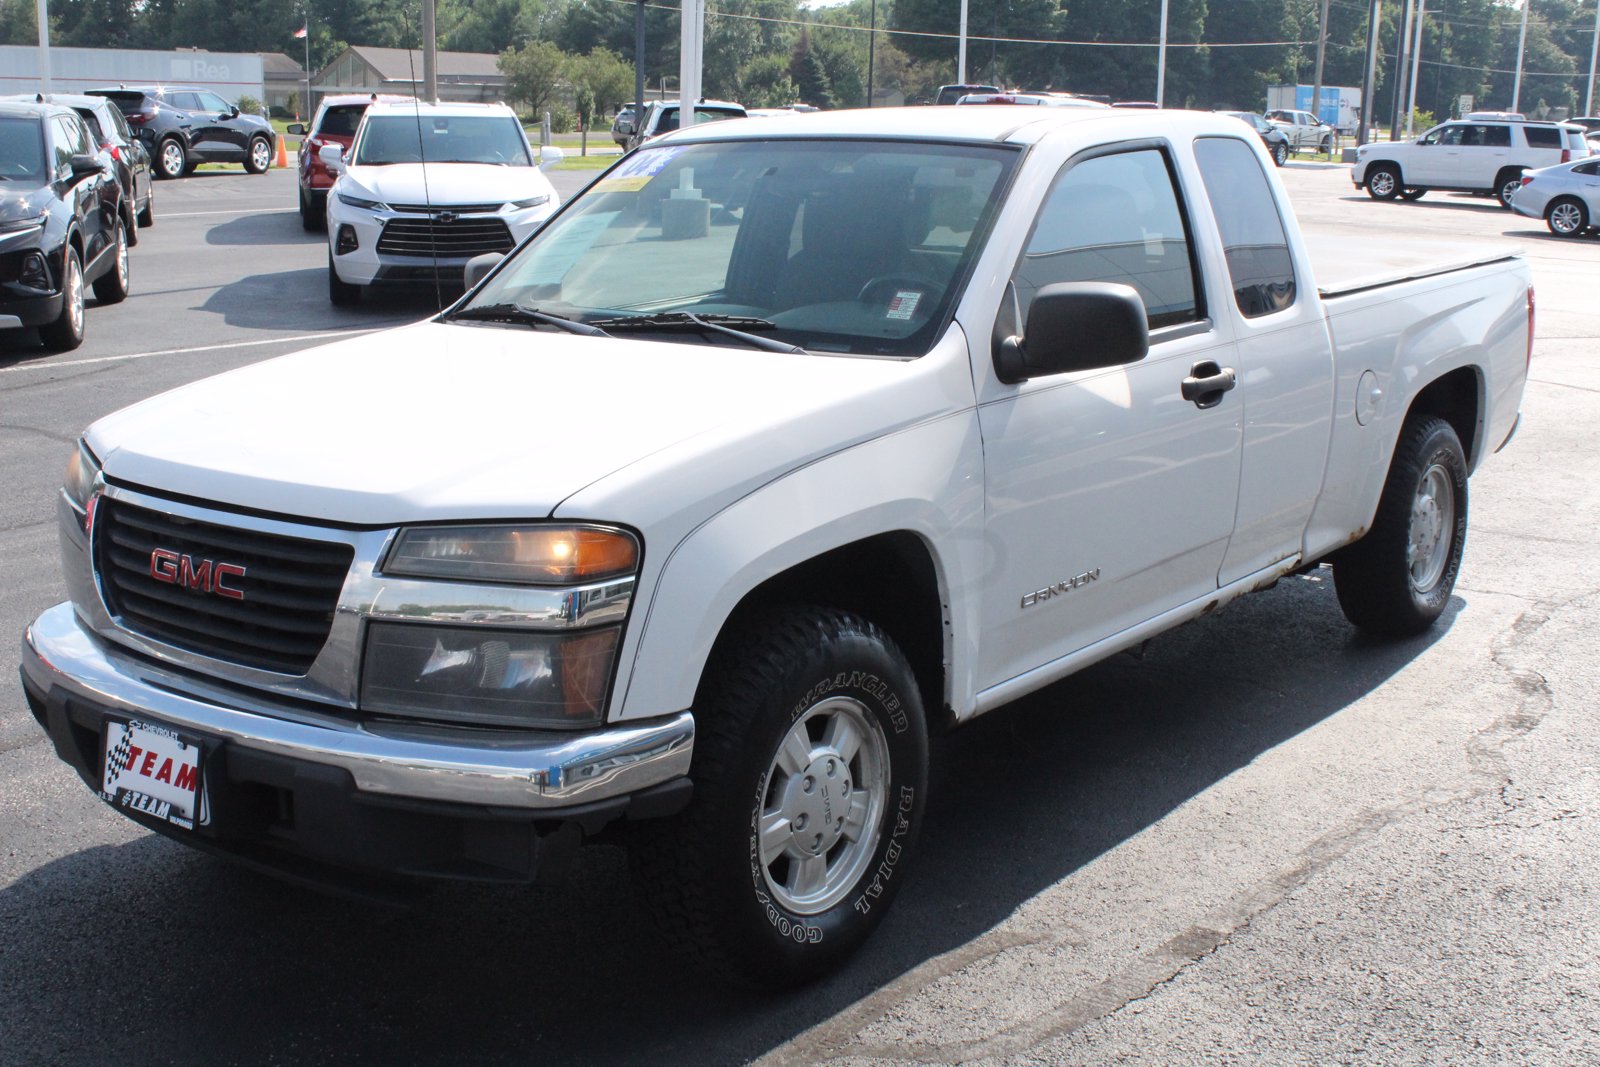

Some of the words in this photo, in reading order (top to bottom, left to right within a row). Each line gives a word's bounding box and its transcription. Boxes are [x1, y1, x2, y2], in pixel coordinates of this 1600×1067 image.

[193, 61, 230, 79] Rea
[151, 547, 247, 600] GMC
[1020, 567, 1101, 609] CANYON
[790, 671, 909, 733] WRANGLER
[142, 722, 179, 741] CHEVROLET
[125, 744, 198, 792] TEAM
[854, 785, 914, 915] RADIAL
